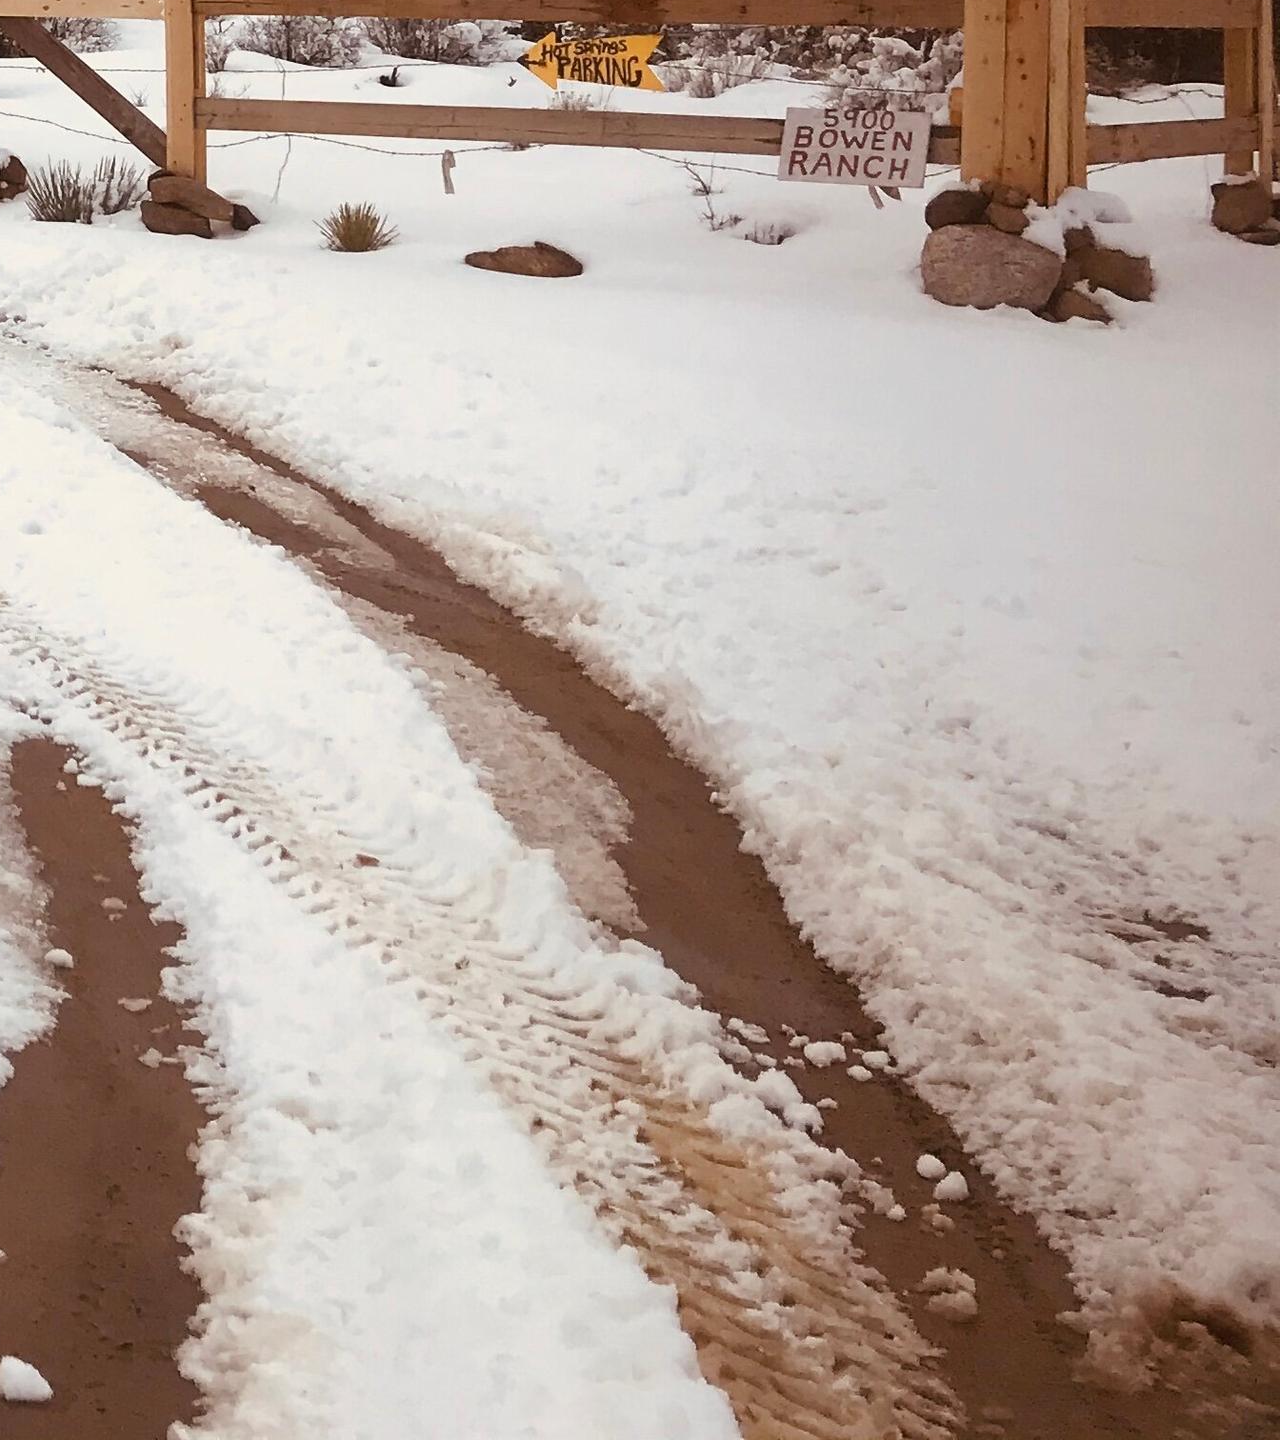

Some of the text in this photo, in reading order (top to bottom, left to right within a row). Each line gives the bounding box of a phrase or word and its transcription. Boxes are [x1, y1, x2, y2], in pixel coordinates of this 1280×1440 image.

[541, 43, 572, 61] HOT
[557, 56, 643, 87] PARKING
[824, 108, 896, 131] 5900
[793, 126, 913, 152] BOWEN
[788, 150, 909, 180] RANCH
